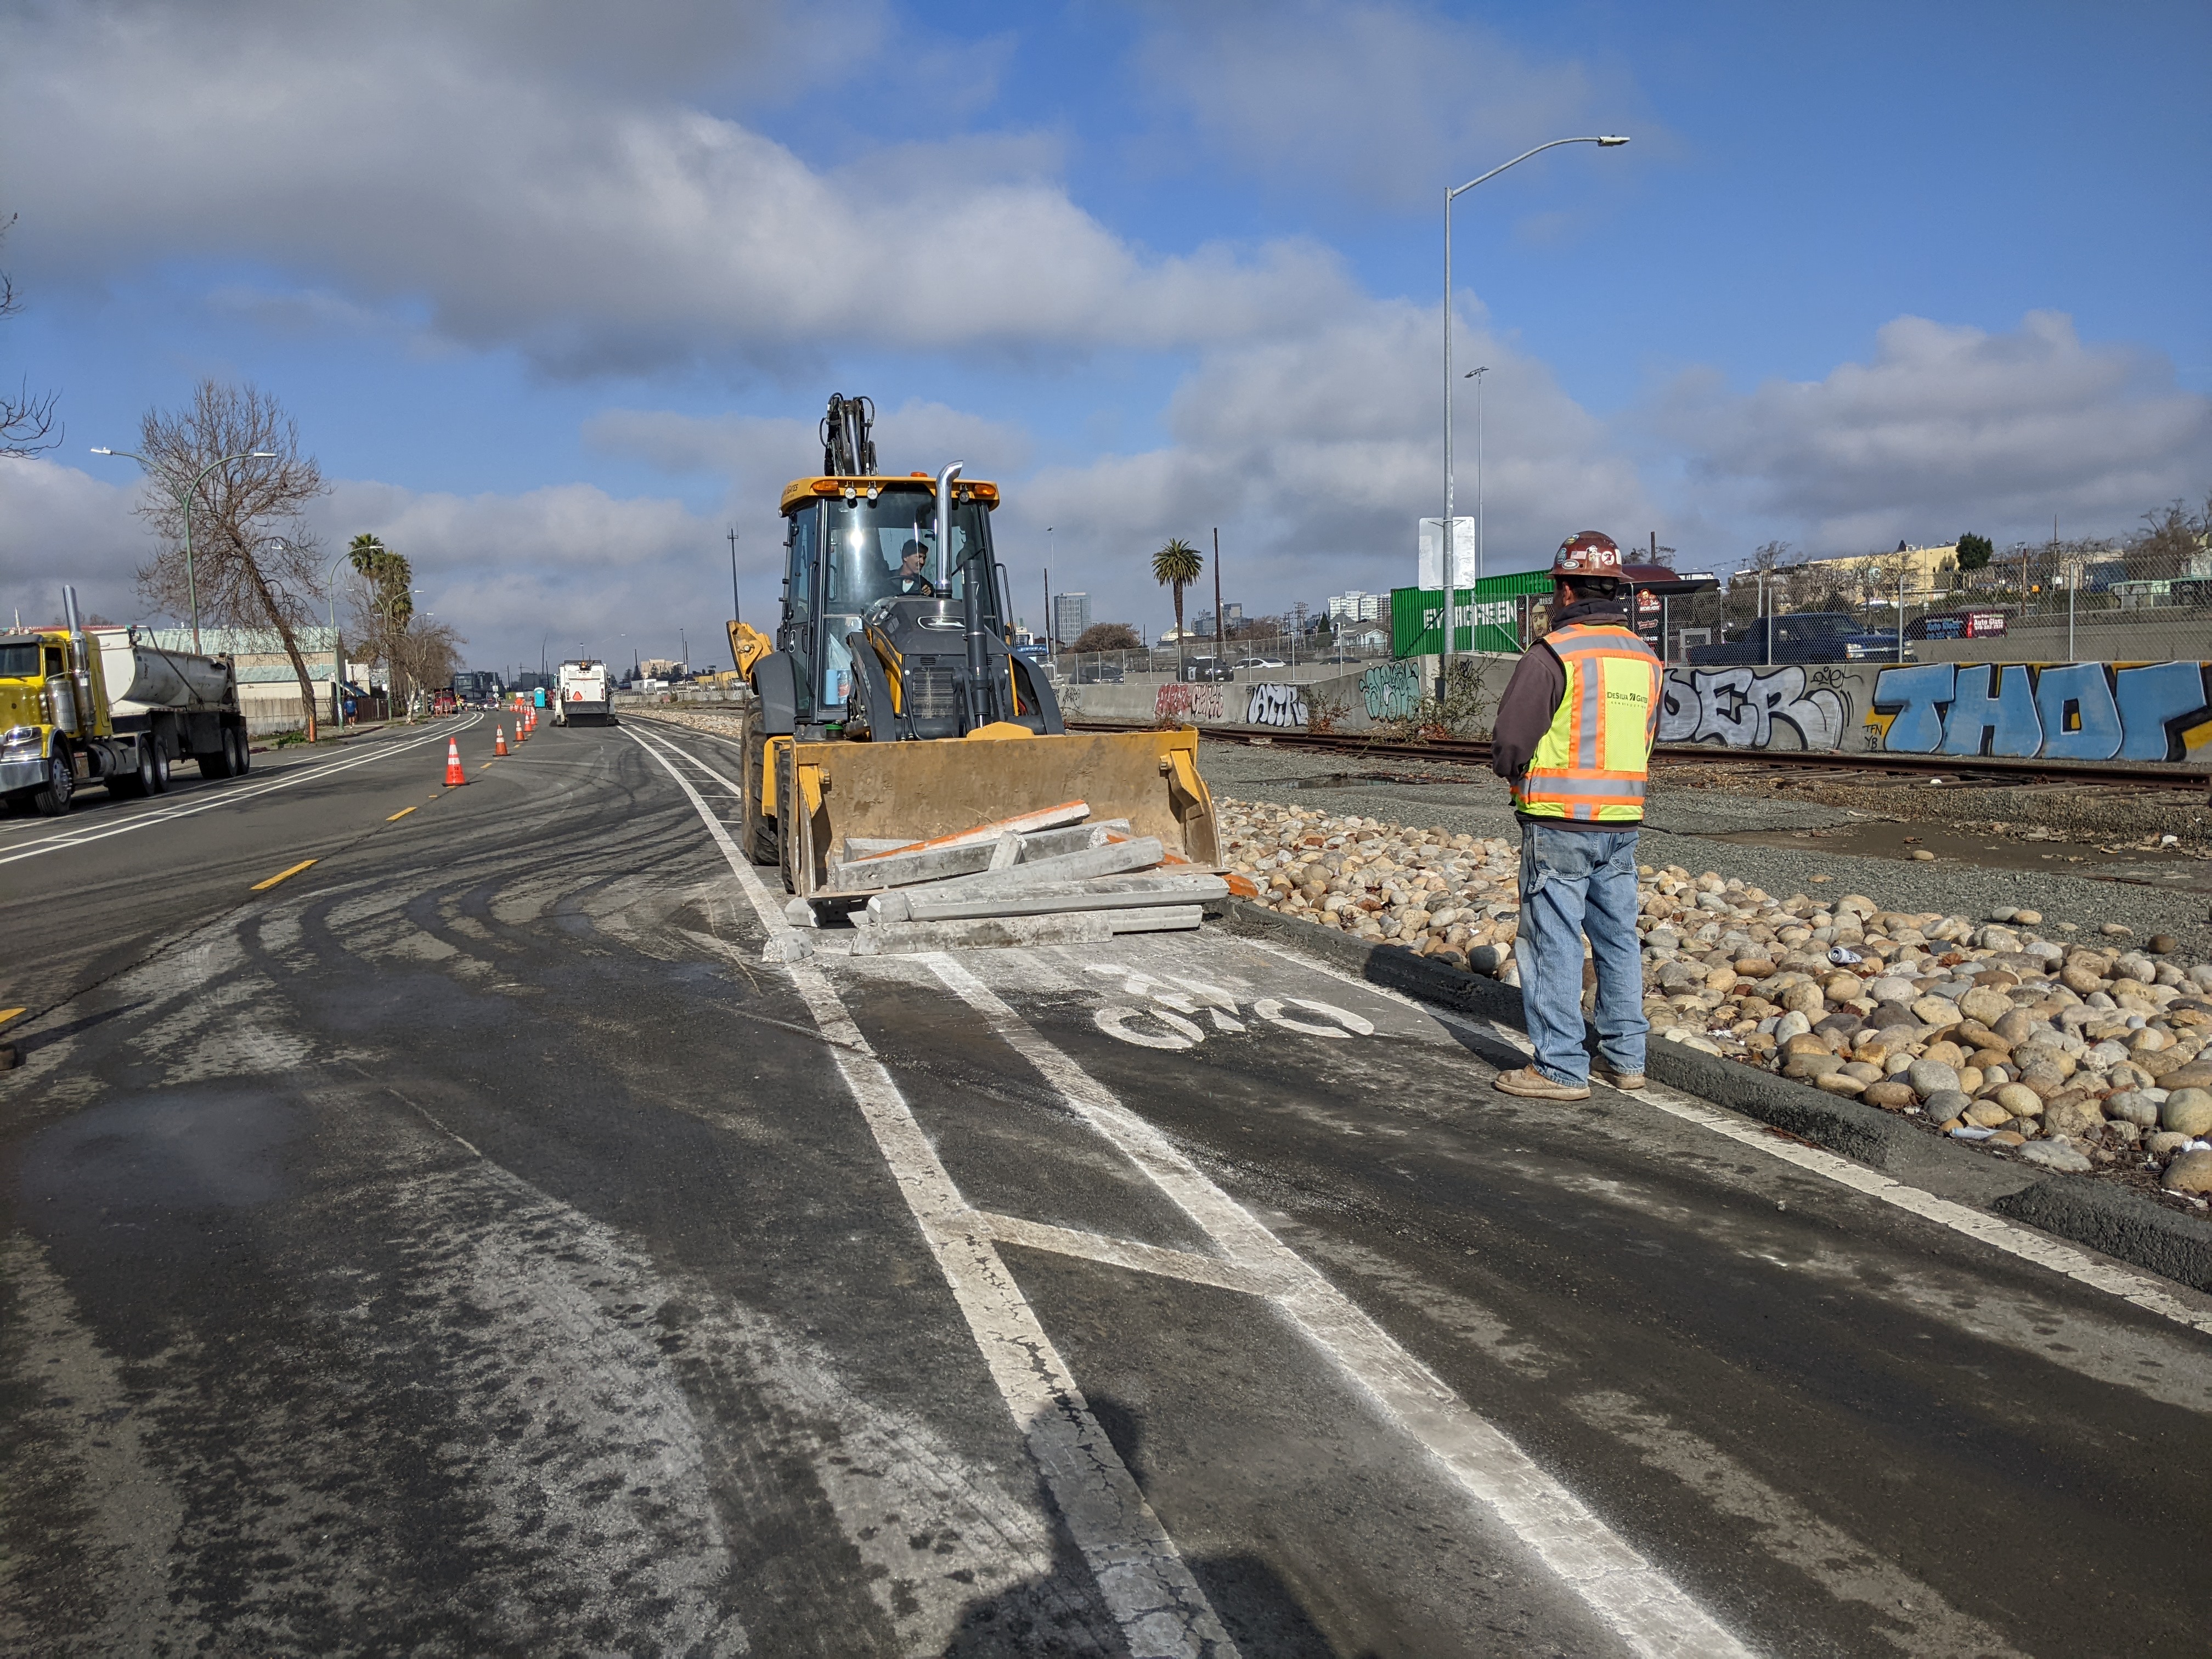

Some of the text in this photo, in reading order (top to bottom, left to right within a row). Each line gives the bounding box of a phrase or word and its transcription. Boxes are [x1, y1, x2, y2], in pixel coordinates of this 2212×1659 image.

[1423, 599, 1518, 630] EVRGREEN
[1637, 695, 1648, 704] GATES
[1863, 724, 1883, 735] TFN
[1865, 735, 1878, 749] YB
